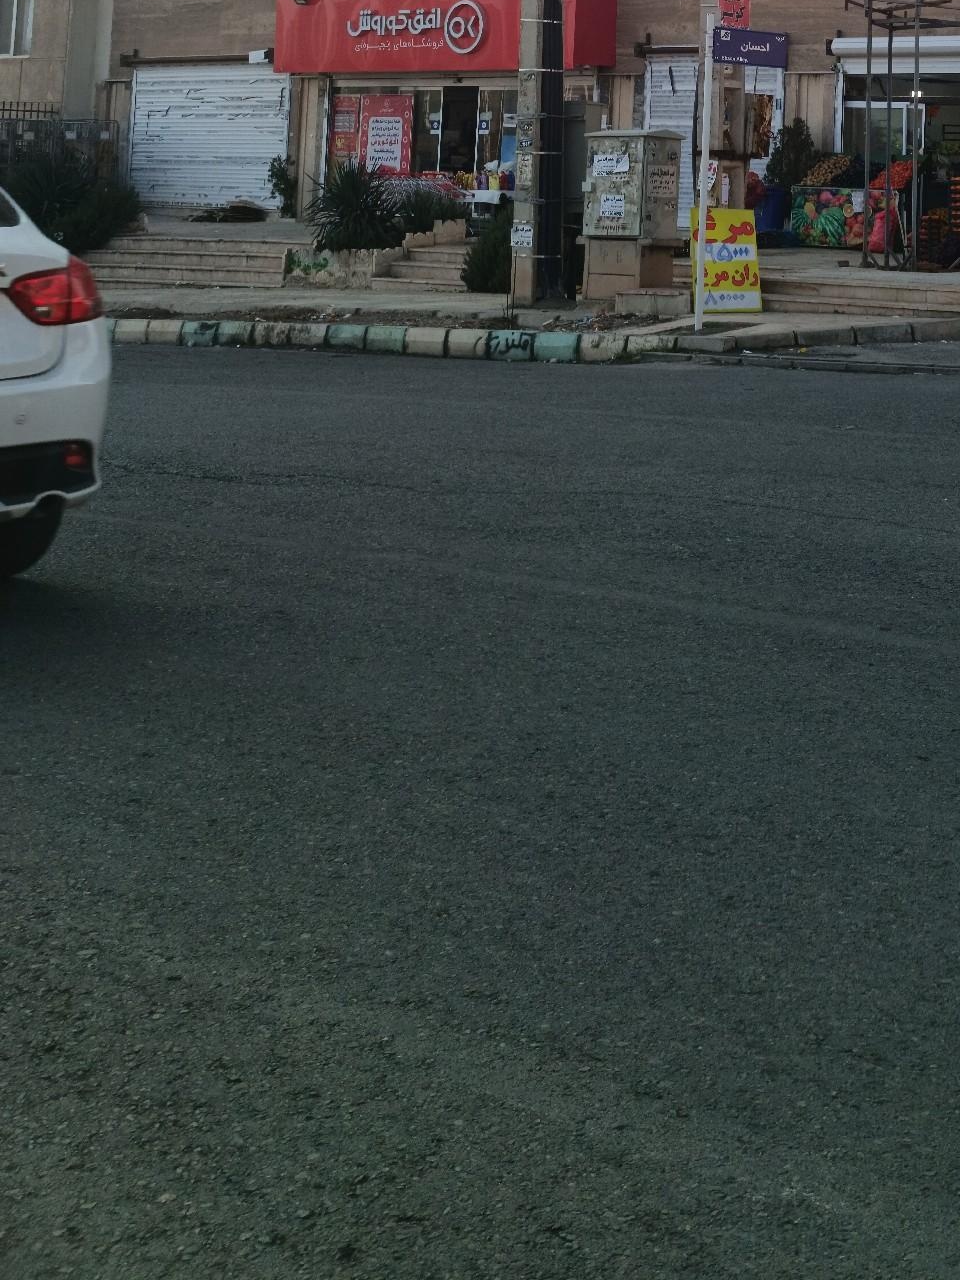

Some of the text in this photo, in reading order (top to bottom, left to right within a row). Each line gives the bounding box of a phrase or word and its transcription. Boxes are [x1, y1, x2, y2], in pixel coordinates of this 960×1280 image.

[347, 7, 441, 37] افق کوروش
[740, 41, 770, 52] احسان
[732, 263, 759, 287] ران
